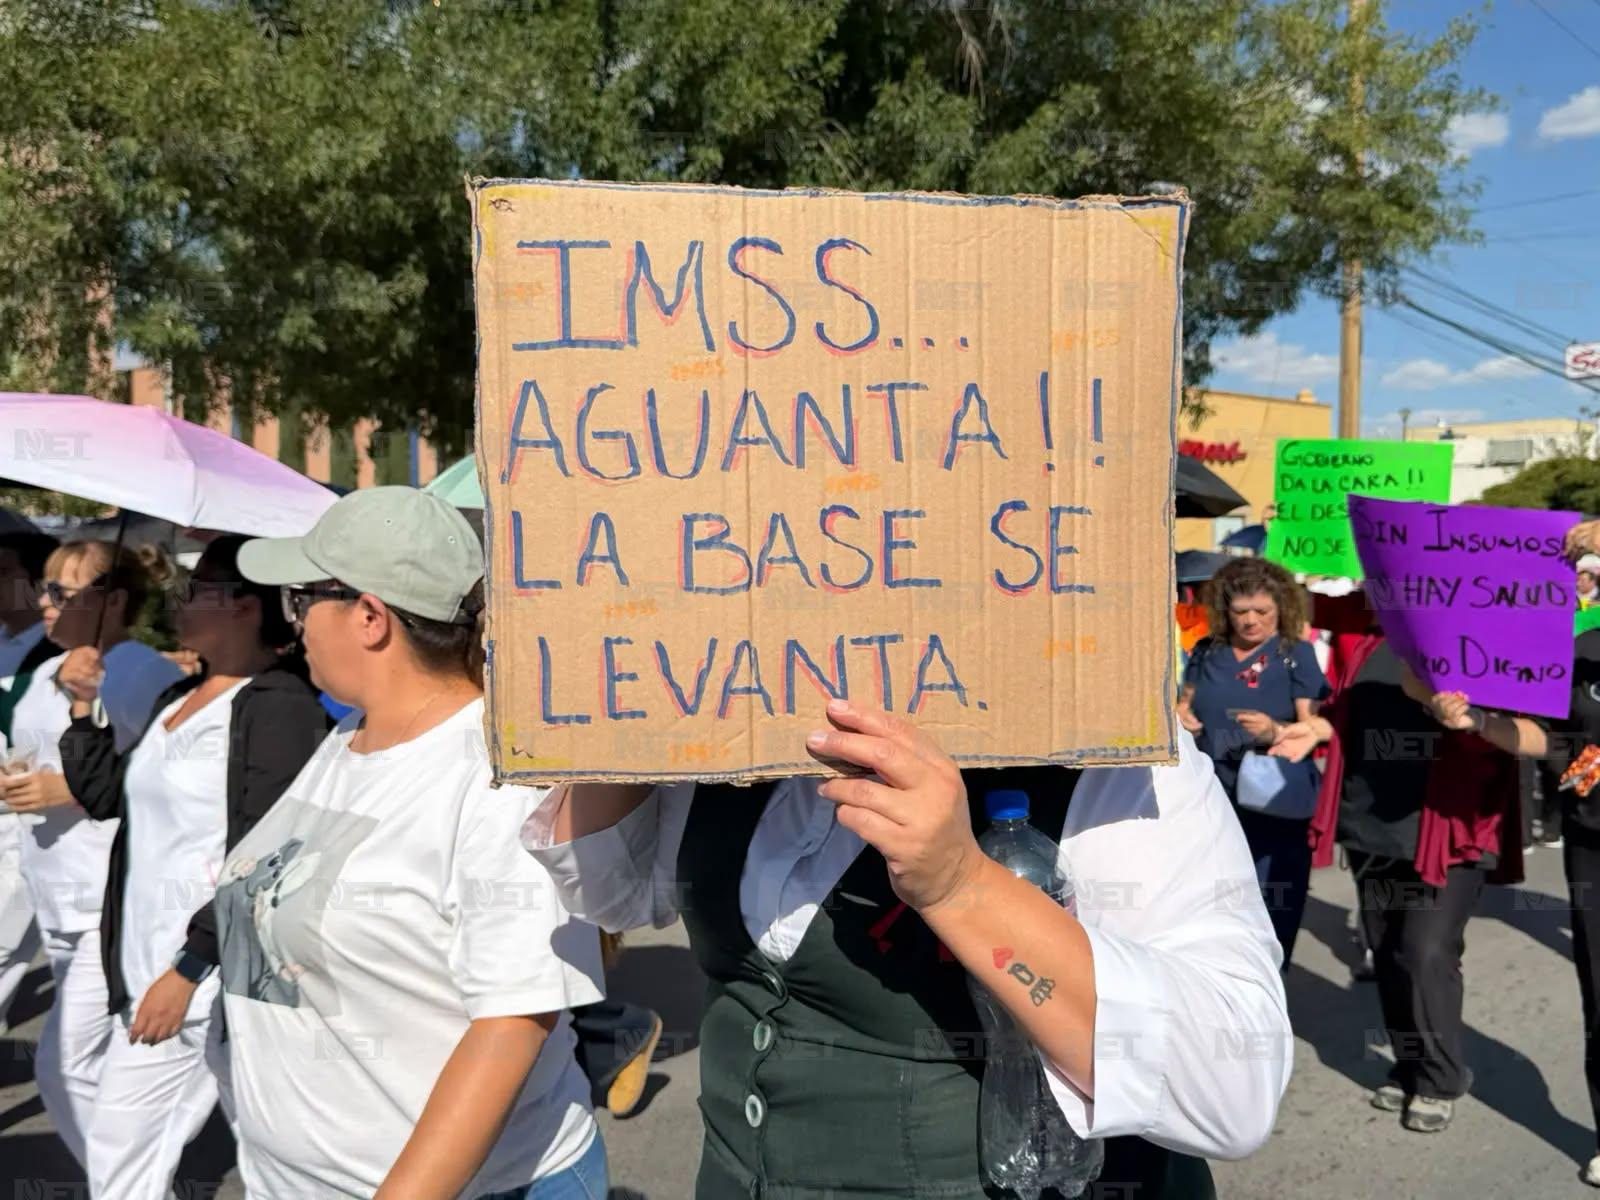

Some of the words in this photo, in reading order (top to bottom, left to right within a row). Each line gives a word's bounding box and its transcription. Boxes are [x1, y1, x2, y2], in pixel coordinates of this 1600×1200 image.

[511, 236, 970, 358] IMSS...
[1281, 440, 1375, 468] GOBIERNO
[1280, 473, 1306, 492] DA
[1311, 479, 1334, 493] LA
[1338, 474, 1399, 492] CARA
[1276, 502, 1303, 521] EL
[508, 510, 630, 597] LA
[677, 504, 942, 595] BASE
[990, 500, 1096, 597] SE
[1282, 537, 1317, 558] NO
[1324, 538, 1347, 557] SE
[1404, 573, 1462, 608] HAY
[1459, 634, 1567, 684] DIGNO
[537, 634, 988, 729] LEVANTA.
